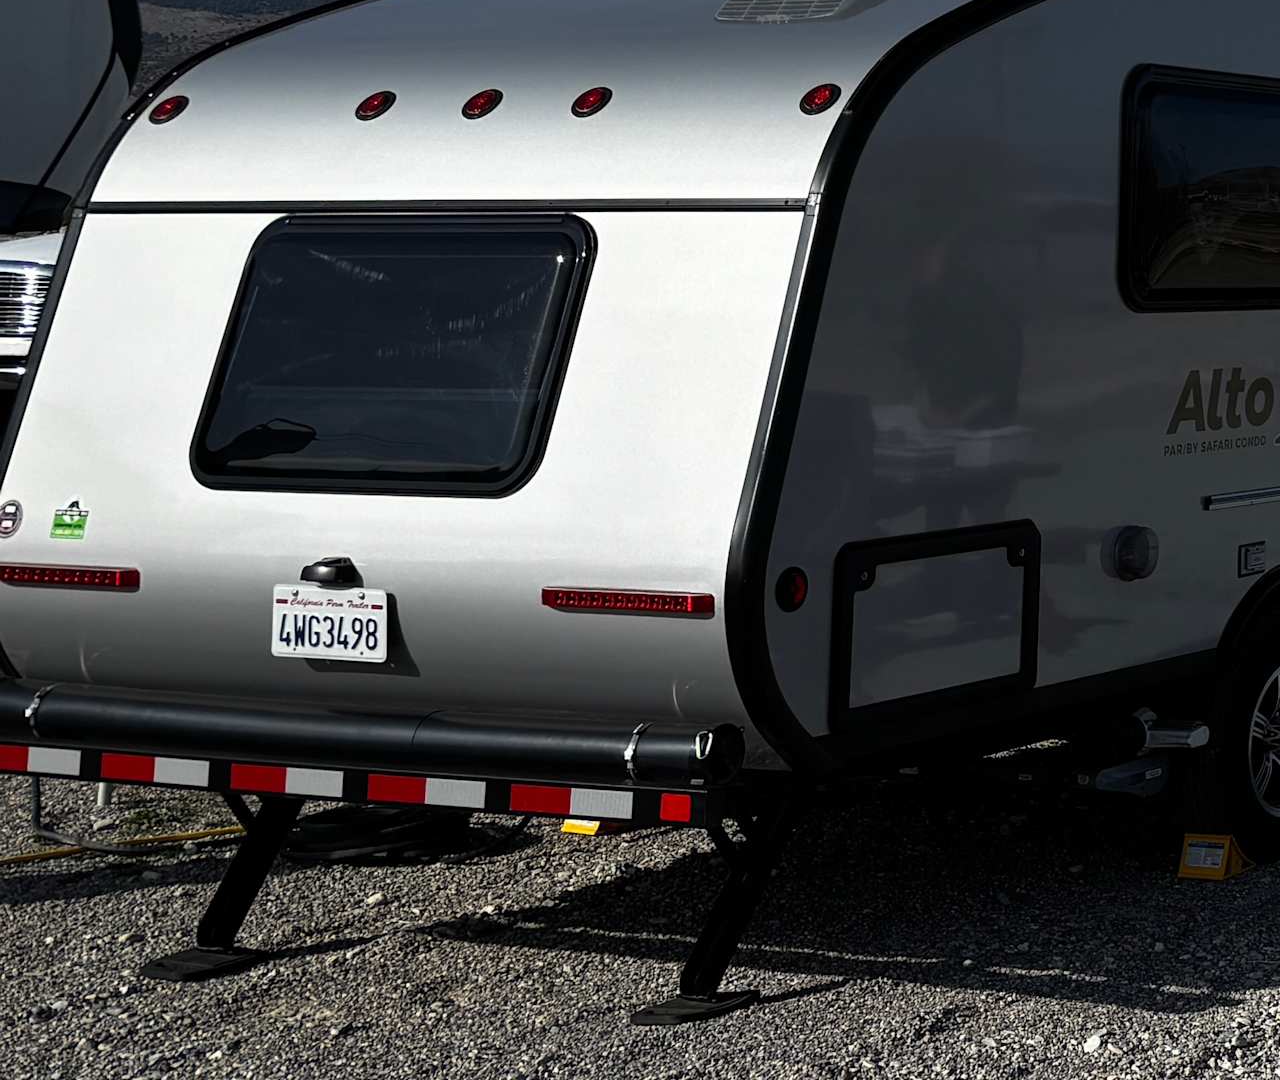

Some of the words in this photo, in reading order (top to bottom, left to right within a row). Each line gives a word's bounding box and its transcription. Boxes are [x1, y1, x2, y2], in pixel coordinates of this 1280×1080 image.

[1166, 368, 1274, 435] Alto
[1201, 439, 1233, 453] SAFARI
[1235, 436, 1267, 448] CONDO
[290, 598, 323, 608] California
[347, 600, 369, 609] Trailer
[280, 614, 377, 651] 4WG3498
